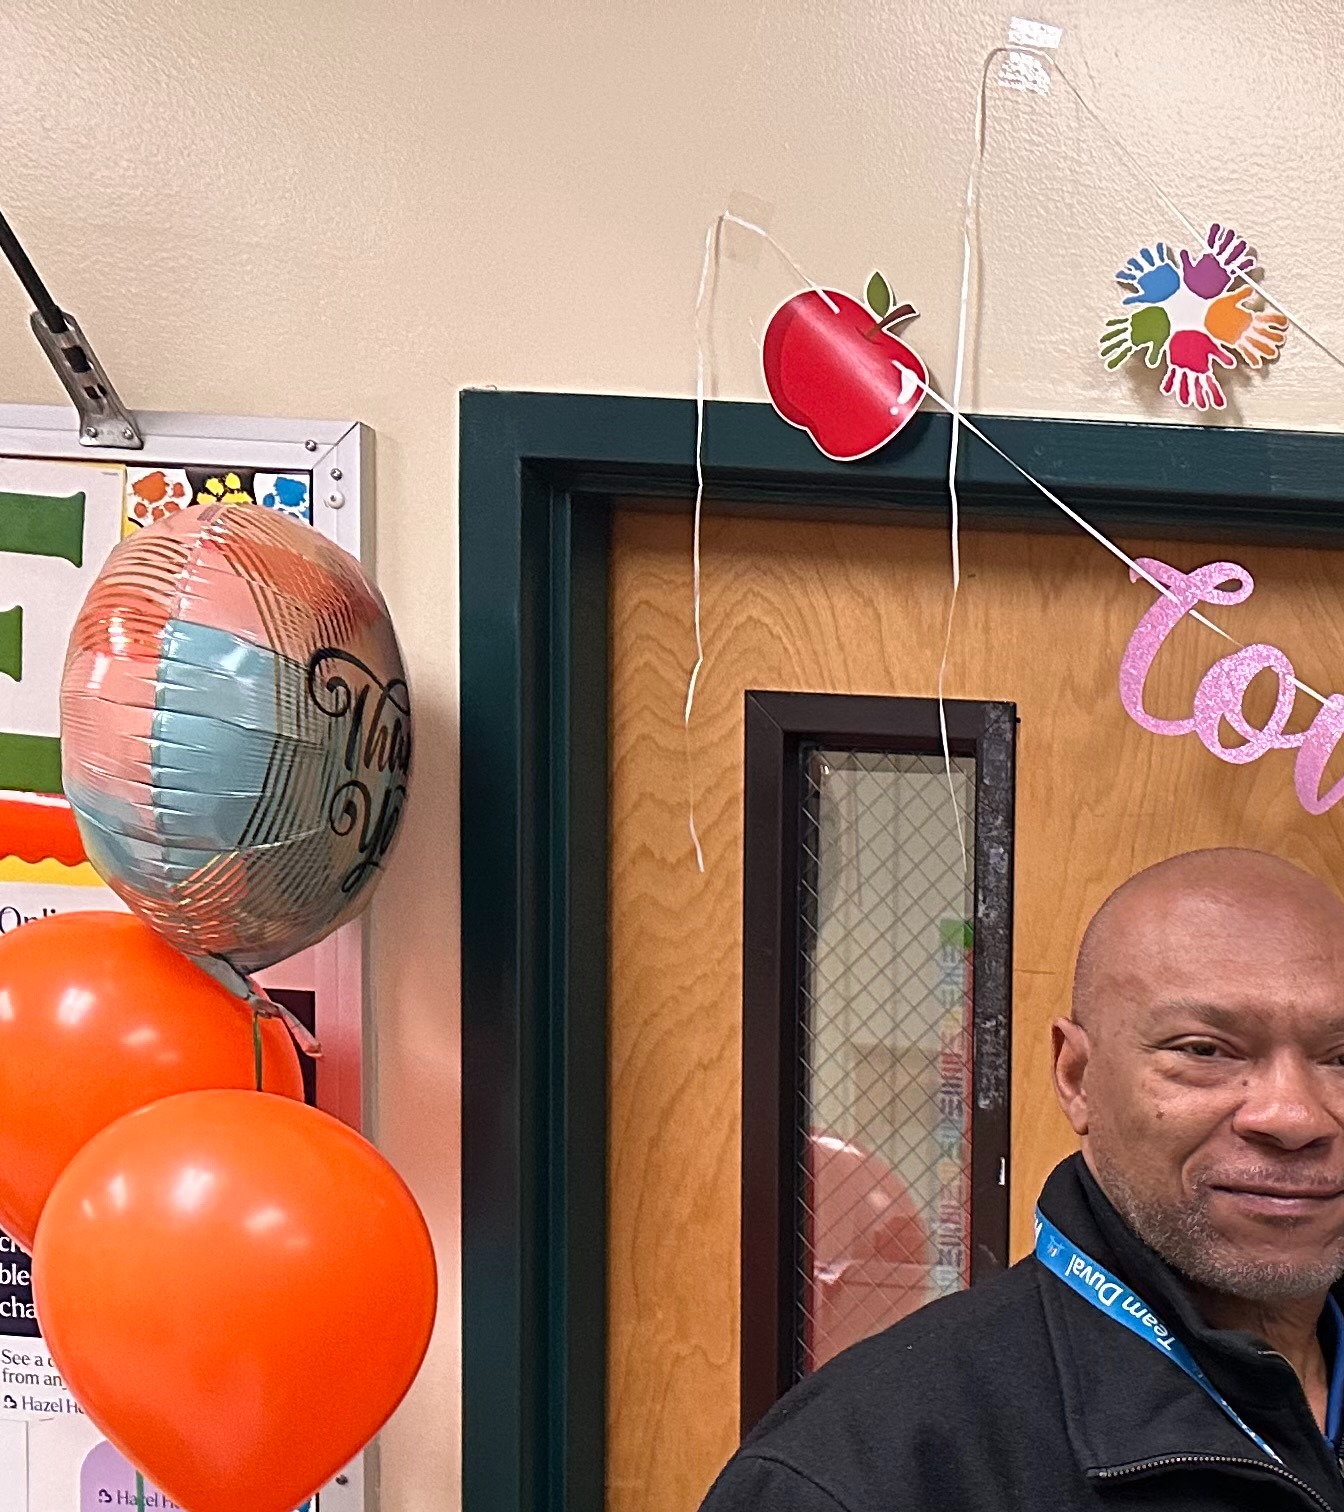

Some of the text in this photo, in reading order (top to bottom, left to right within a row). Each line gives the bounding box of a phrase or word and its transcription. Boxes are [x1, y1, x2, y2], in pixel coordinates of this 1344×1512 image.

[1064, 1254, 1176, 1351] Team Duval
[1, 1348, 31, 1366] See
[34, 1355, 44, 1367] a
[2, 1367, 39, 1385] from
[22, 1395, 63, 1413] Hazel
[117, 1489, 158, 1508] Hael
